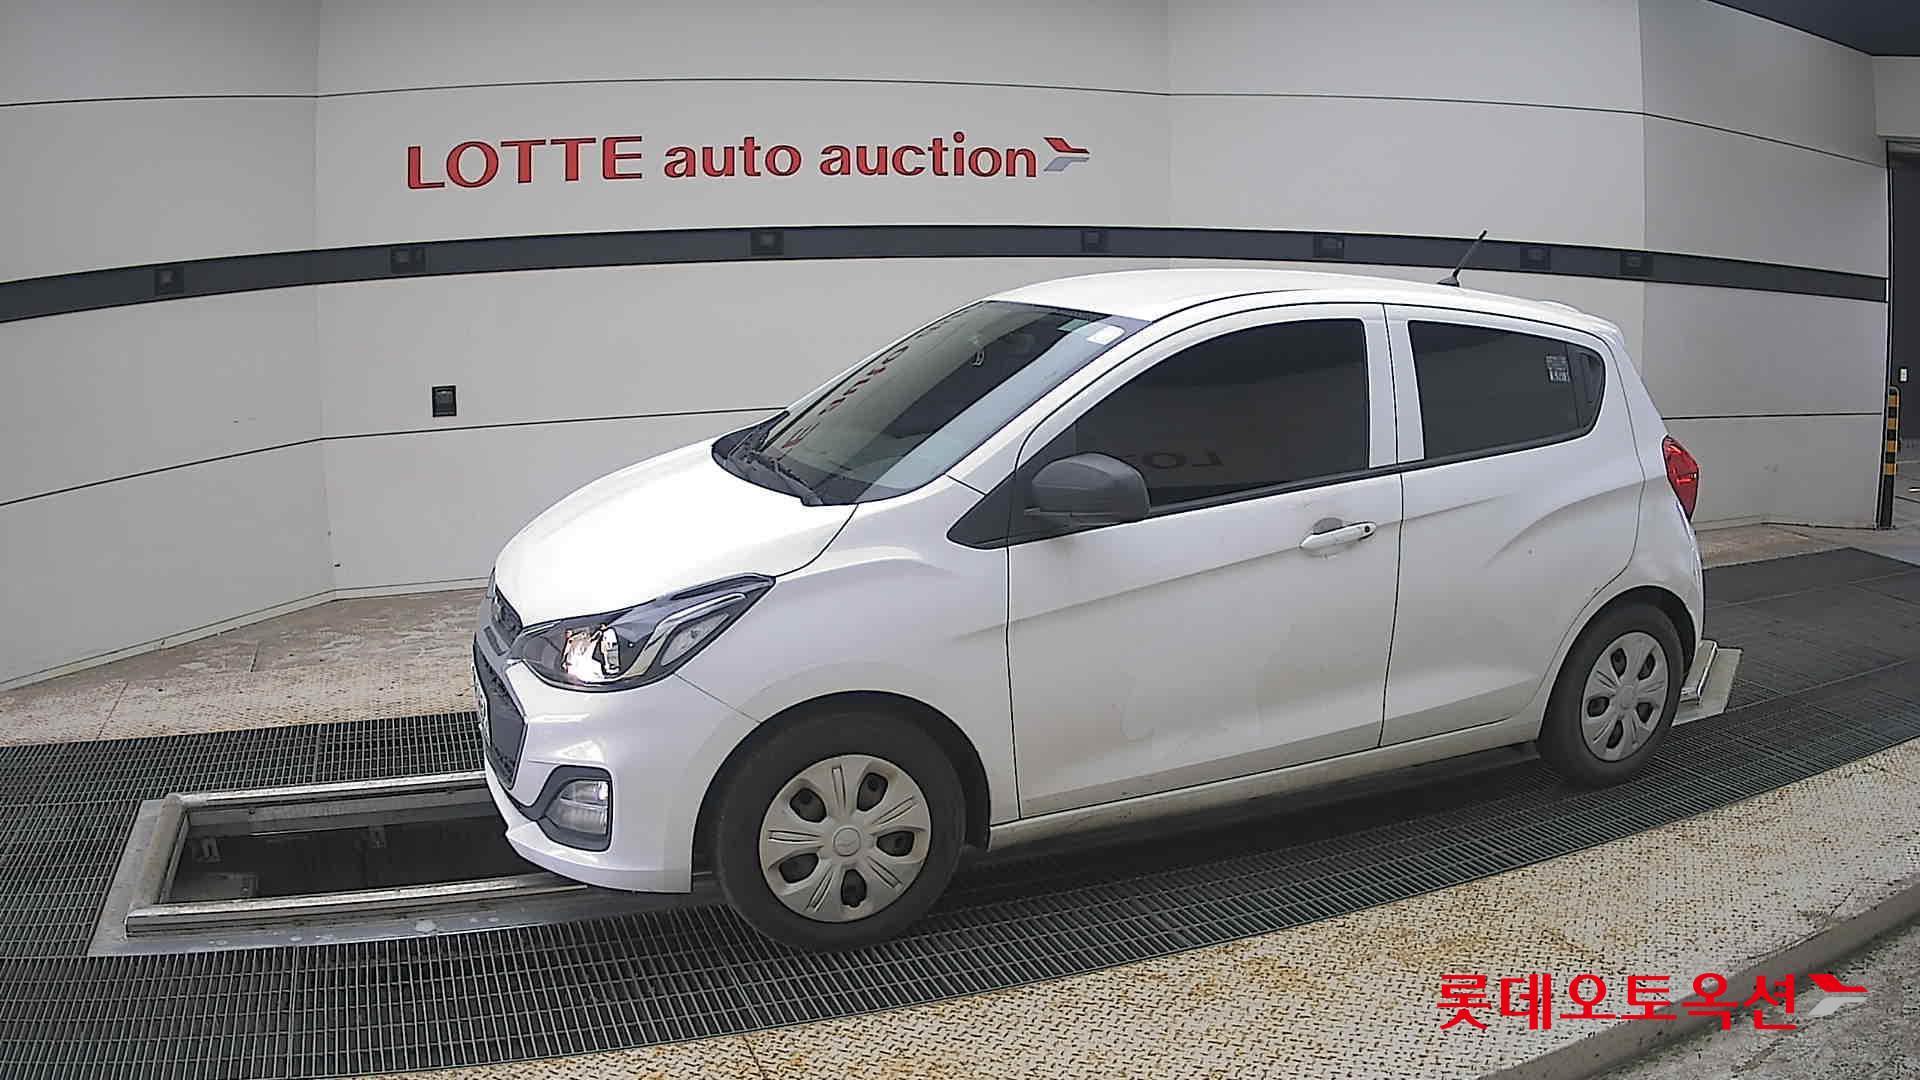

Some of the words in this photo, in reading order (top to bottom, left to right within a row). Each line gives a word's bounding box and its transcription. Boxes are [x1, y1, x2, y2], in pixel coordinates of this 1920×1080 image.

[408, 136, 643, 188] LOTTE
[664, 137, 802, 178] auto
[819, 131, 1037, 178] auction
